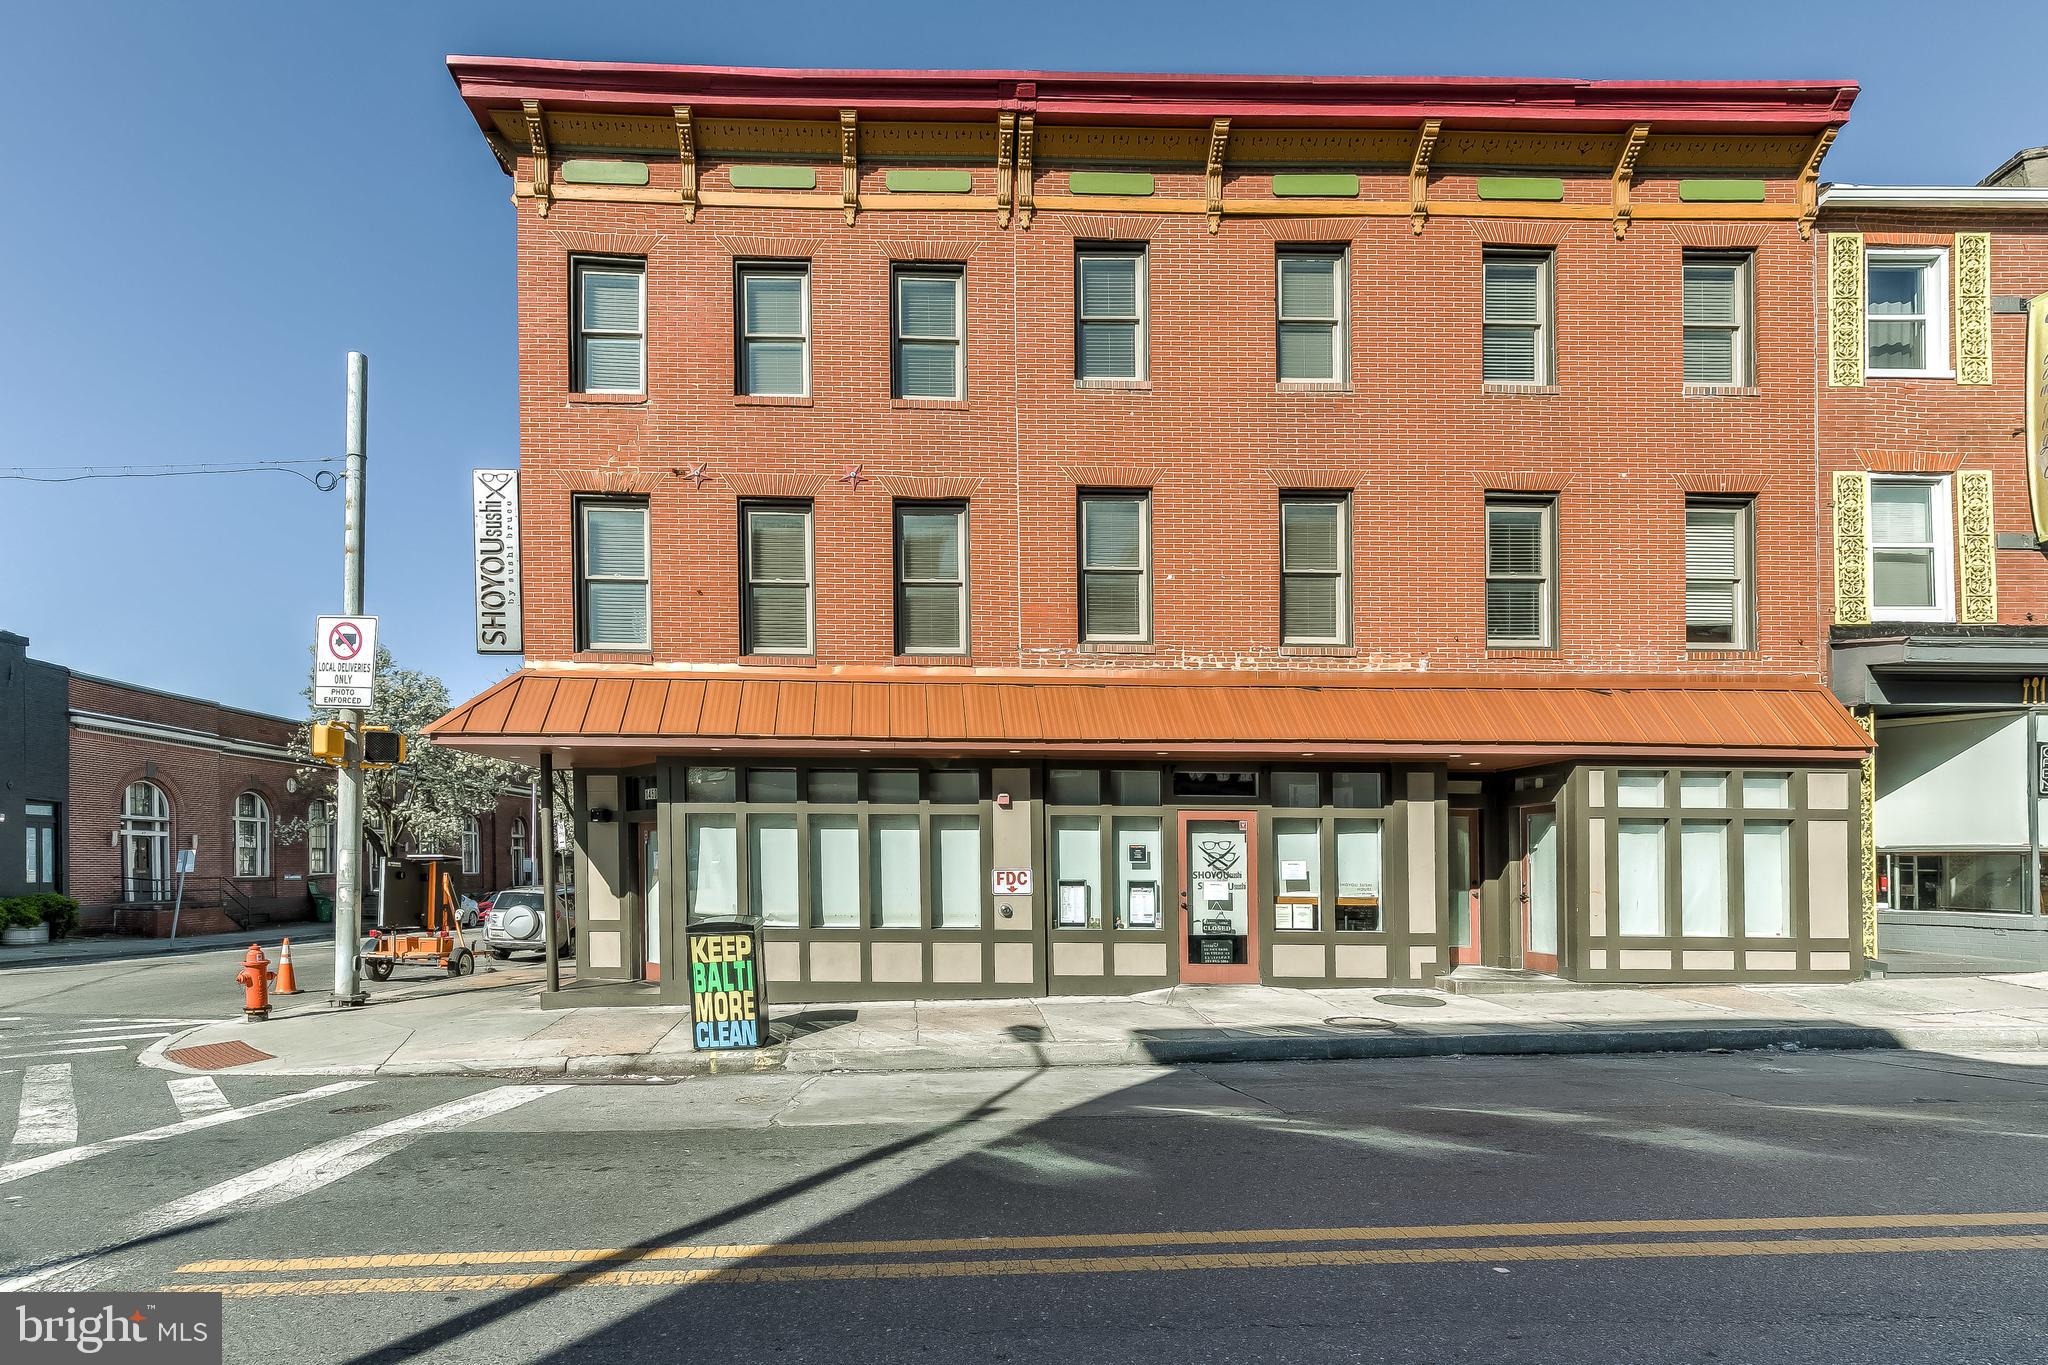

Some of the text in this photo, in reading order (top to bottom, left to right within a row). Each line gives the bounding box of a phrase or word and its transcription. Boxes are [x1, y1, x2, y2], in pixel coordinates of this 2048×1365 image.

[508, 590, 516, 604] by
[318, 662, 371, 672] LOCAL DELIVERIES
[335, 675, 352, 684] ONLY
[996, 871, 1028, 886] FDC
[690, 935, 752, 963] KEEP
[693, 960, 753, 993] BALTI
[695, 990, 755, 1022] MORE
[696, 1020, 757, 1048] CLEAN
